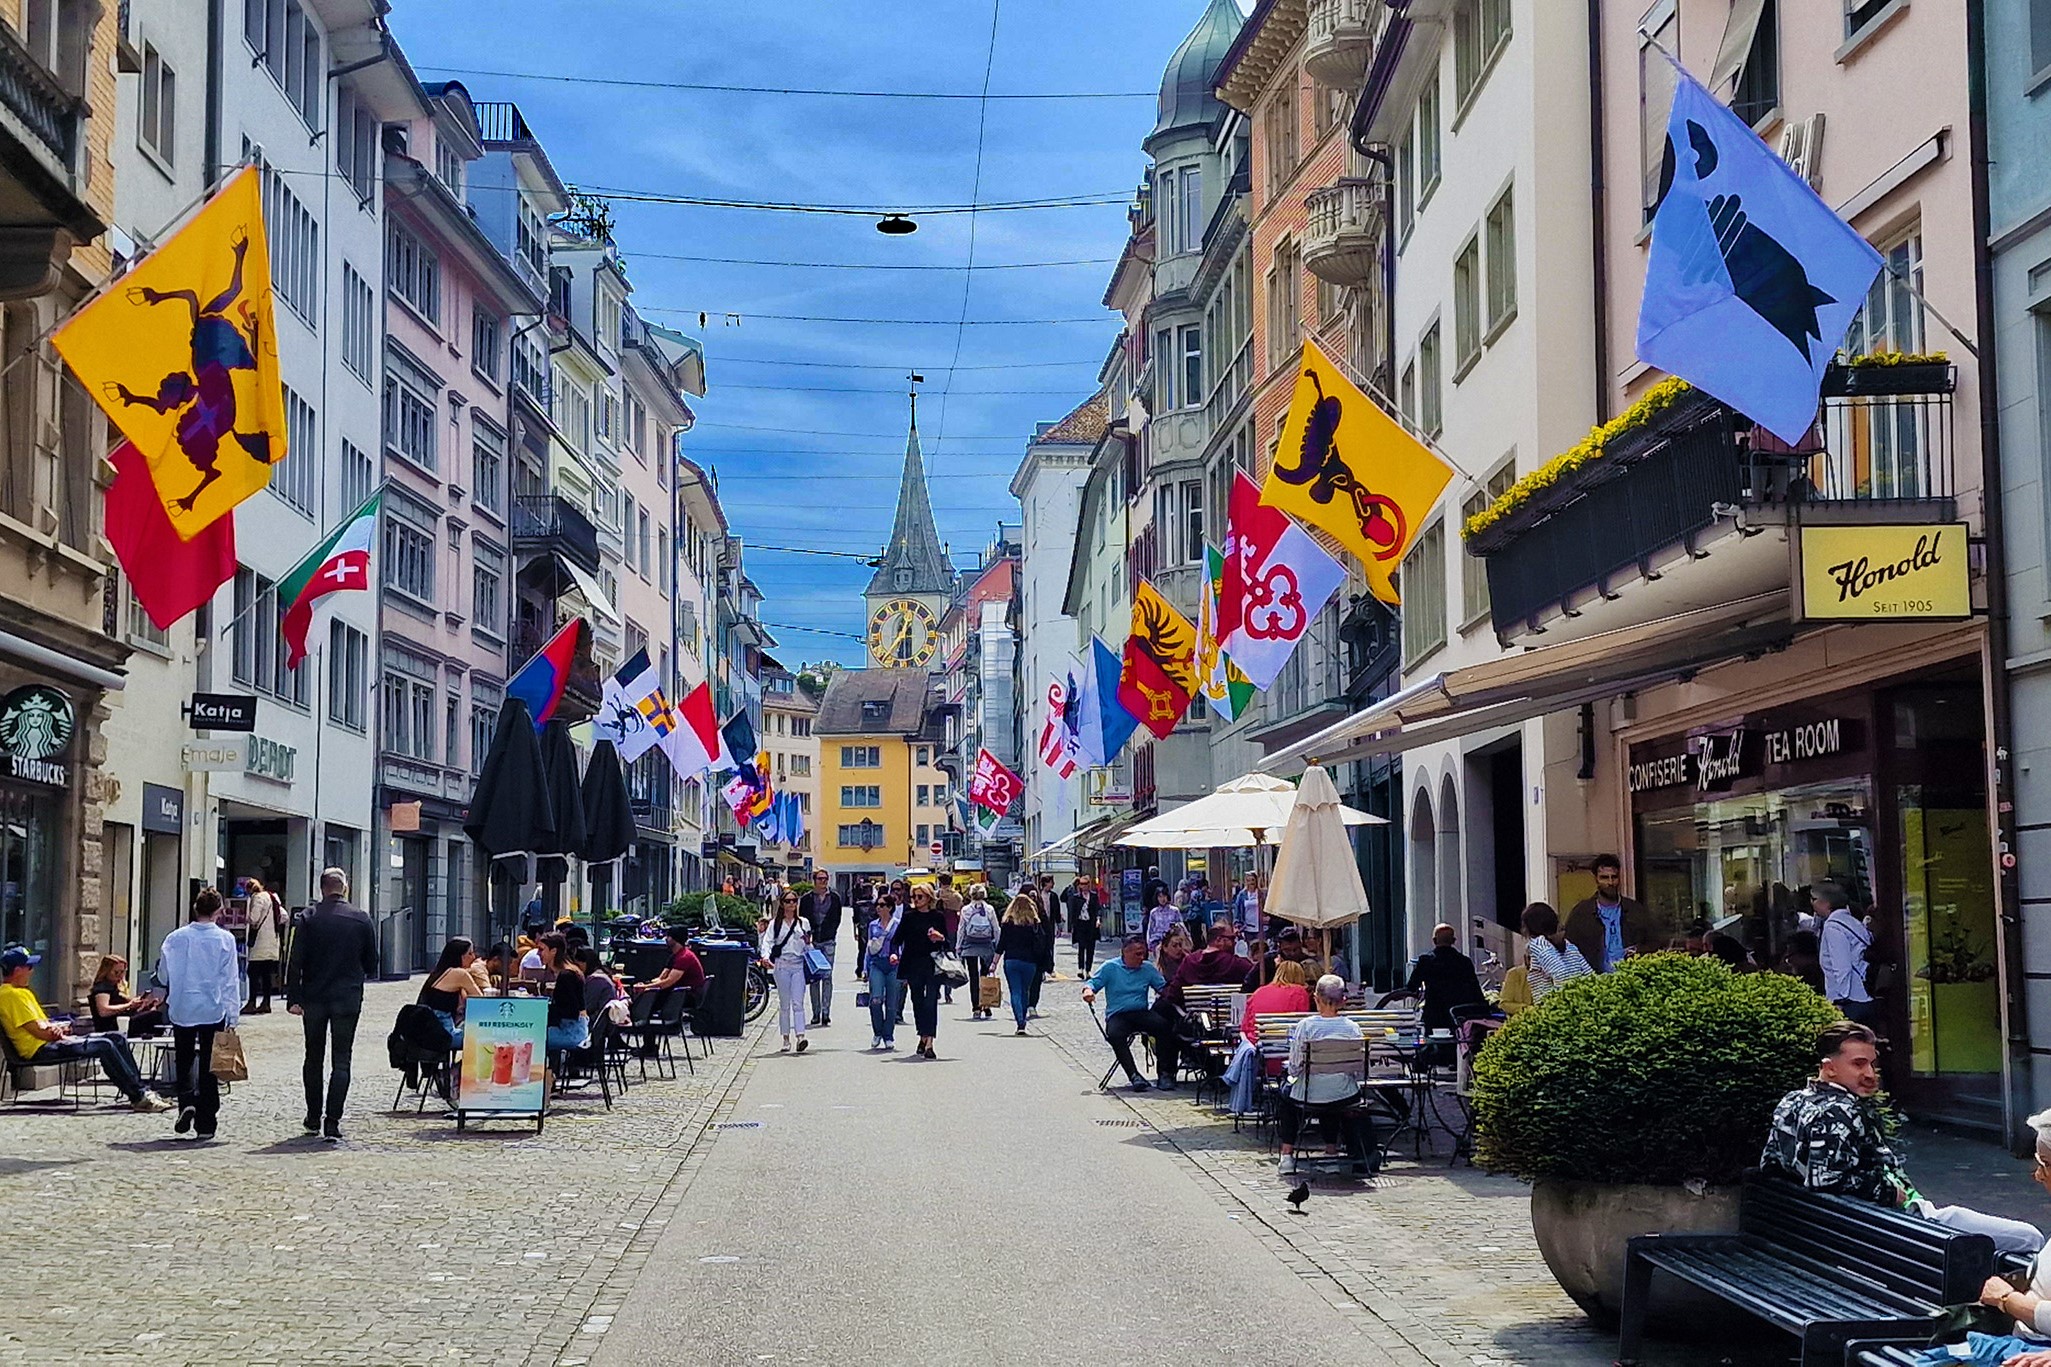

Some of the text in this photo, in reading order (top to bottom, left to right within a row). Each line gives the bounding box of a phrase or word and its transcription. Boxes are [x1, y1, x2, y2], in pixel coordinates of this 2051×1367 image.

[1828, 530, 1942, 602] Honold
[1873, 600, 1934, 613] SEIT 1905
[194, 702, 243, 723] Katja
[11, 754, 65, 786] STARBUCKS
[1628, 718, 1840, 792] CONFISERIE Honold TEA ROOM
